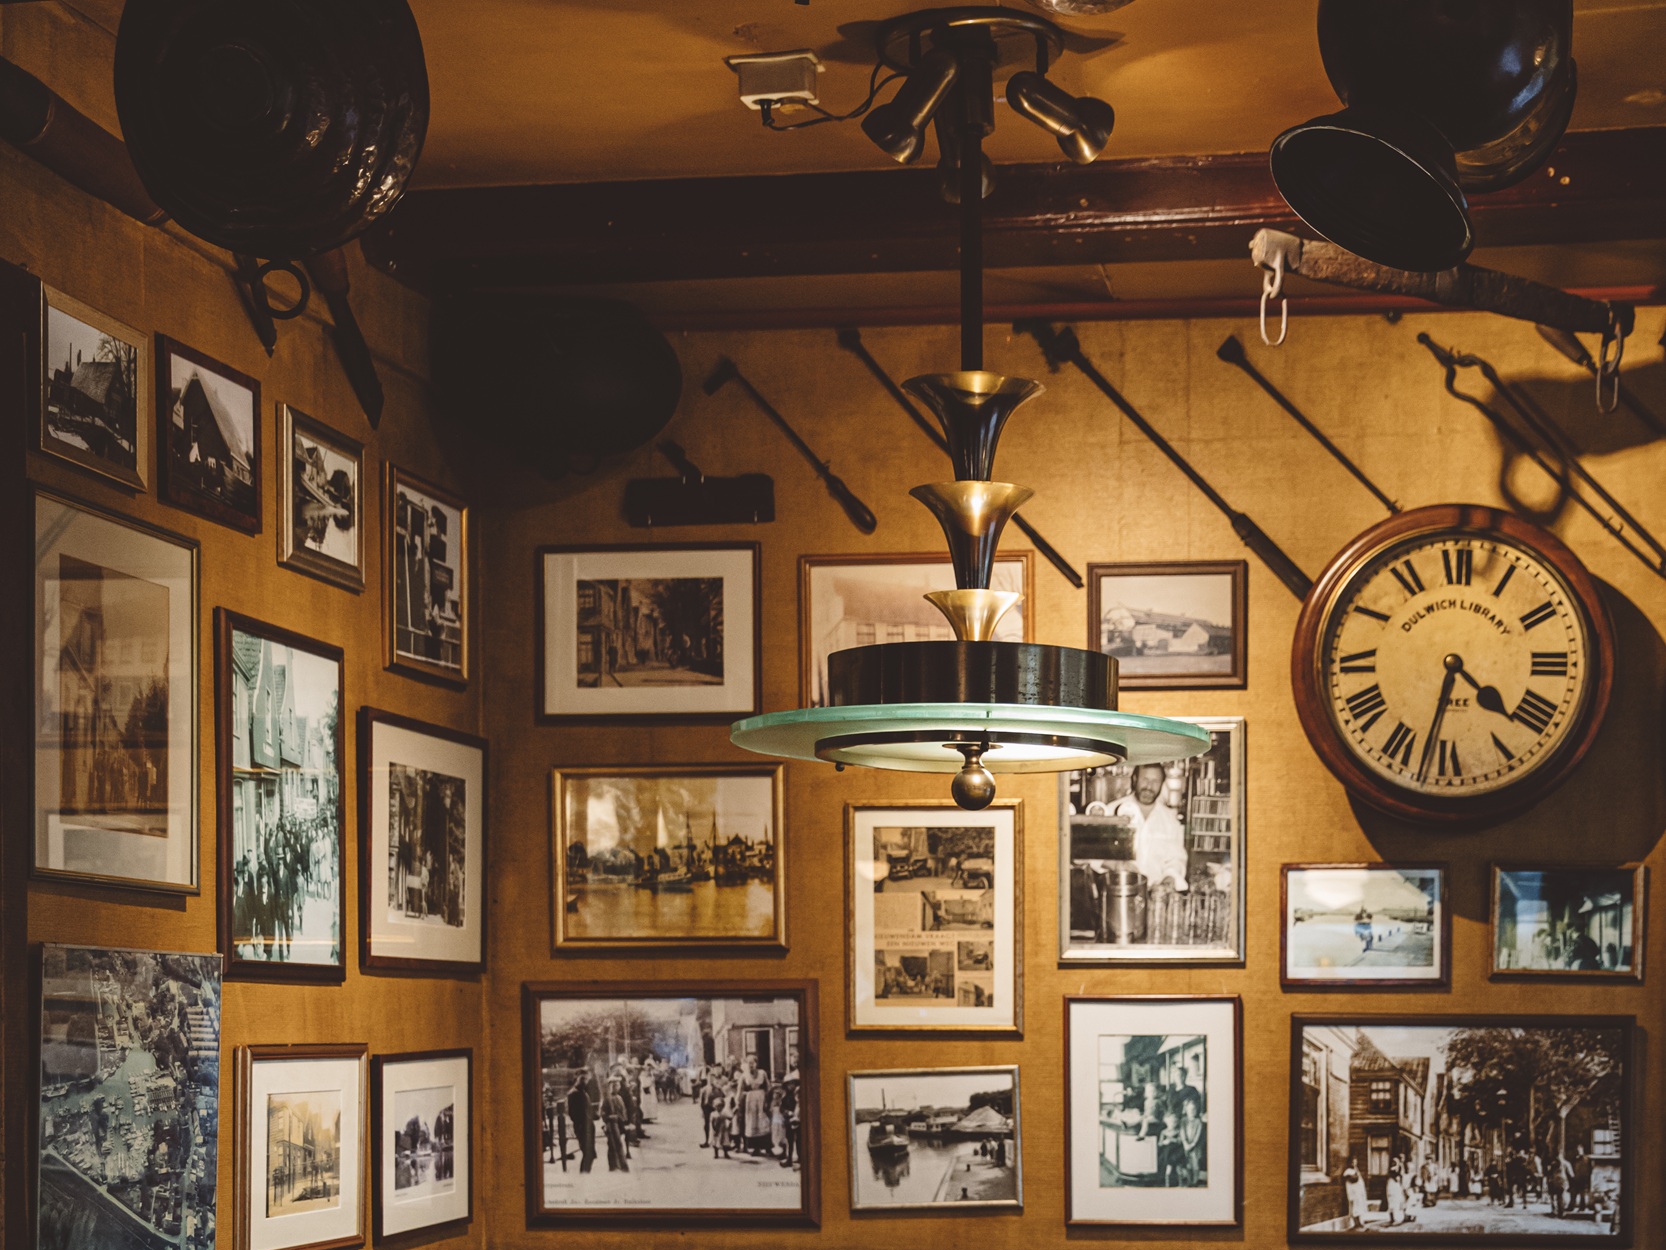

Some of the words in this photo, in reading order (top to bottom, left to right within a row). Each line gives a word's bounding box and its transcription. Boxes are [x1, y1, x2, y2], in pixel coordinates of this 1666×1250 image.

[1401, 599, 1457, 633] DULWICH
[1460, 599, 1511, 635] LIBRARY
[1519, 600, 1558, 632] II
[1530, 652, 1568, 677] III
